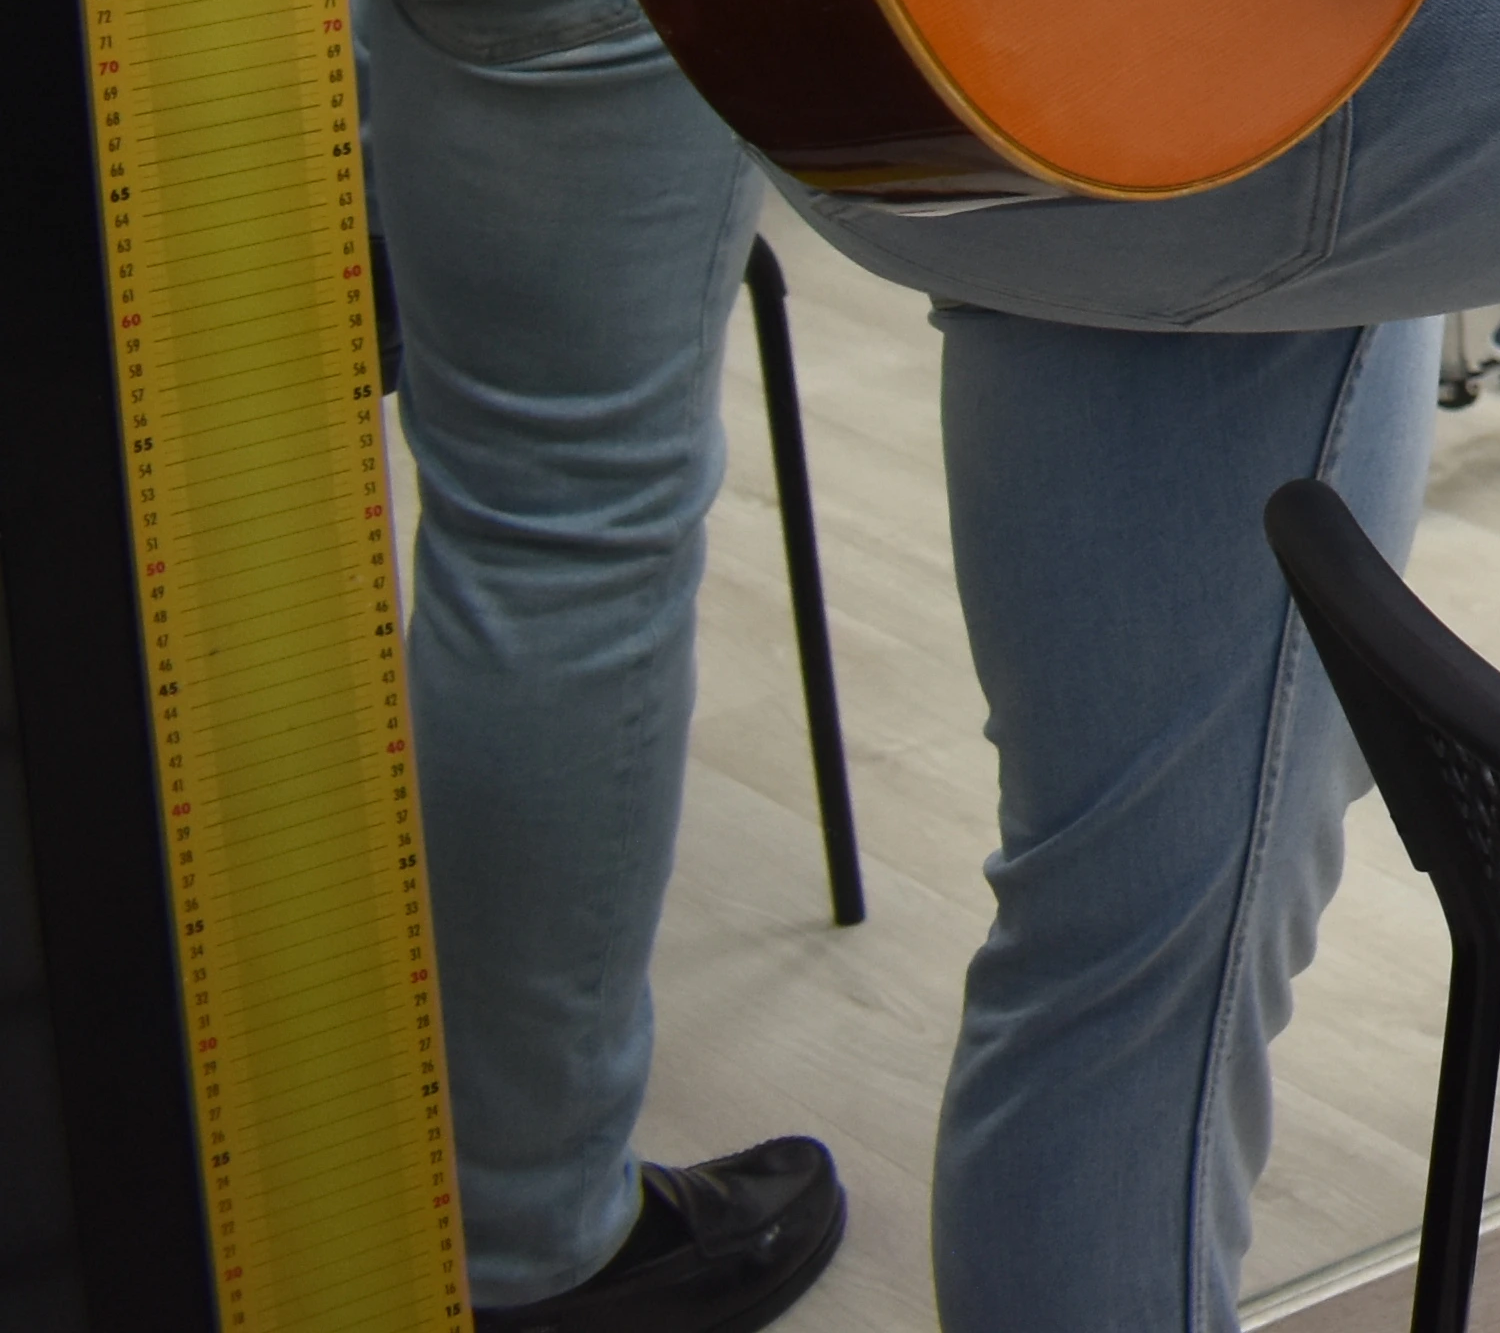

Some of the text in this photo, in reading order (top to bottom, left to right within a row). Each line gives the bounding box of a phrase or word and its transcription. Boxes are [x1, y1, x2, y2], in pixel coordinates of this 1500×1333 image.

[322, 18, 344, 34] 70
[326, 43, 342, 59] 69
[98, 59, 120, 76] 70
[328, 68, 344, 84] 68
[330, 92, 344, 109] 67
[332, 118, 347, 133] 66
[332, 141, 352, 158] 65
[336, 167, 351, 182] 64
[109, 186, 131, 204] 65
[338, 191, 353, 207] 63
[340, 216, 355, 231] 62
[343, 241, 354, 255] 61
[342, 264, 362, 280] 60
[347, 288, 361, 304] 59
[121, 313, 142, 329] 60
[349, 313, 363, 328] 58
[351, 337, 364, 352] 57
[353, 362, 367, 376] 56
[353, 384, 373, 401] 55
[133, 436, 154, 454] 55
[364, 504, 384, 521] 50
[146, 560, 166, 577] 50
[374, 621, 395, 637] 45
[386, 738, 407, 755] 40
[398, 853, 418, 871] 35
[410, 968, 429, 985] 30
[421, 1080, 440, 1098] 25
[432, 1192, 452, 1209] 20
[445, 1302, 462, 1318] 15
